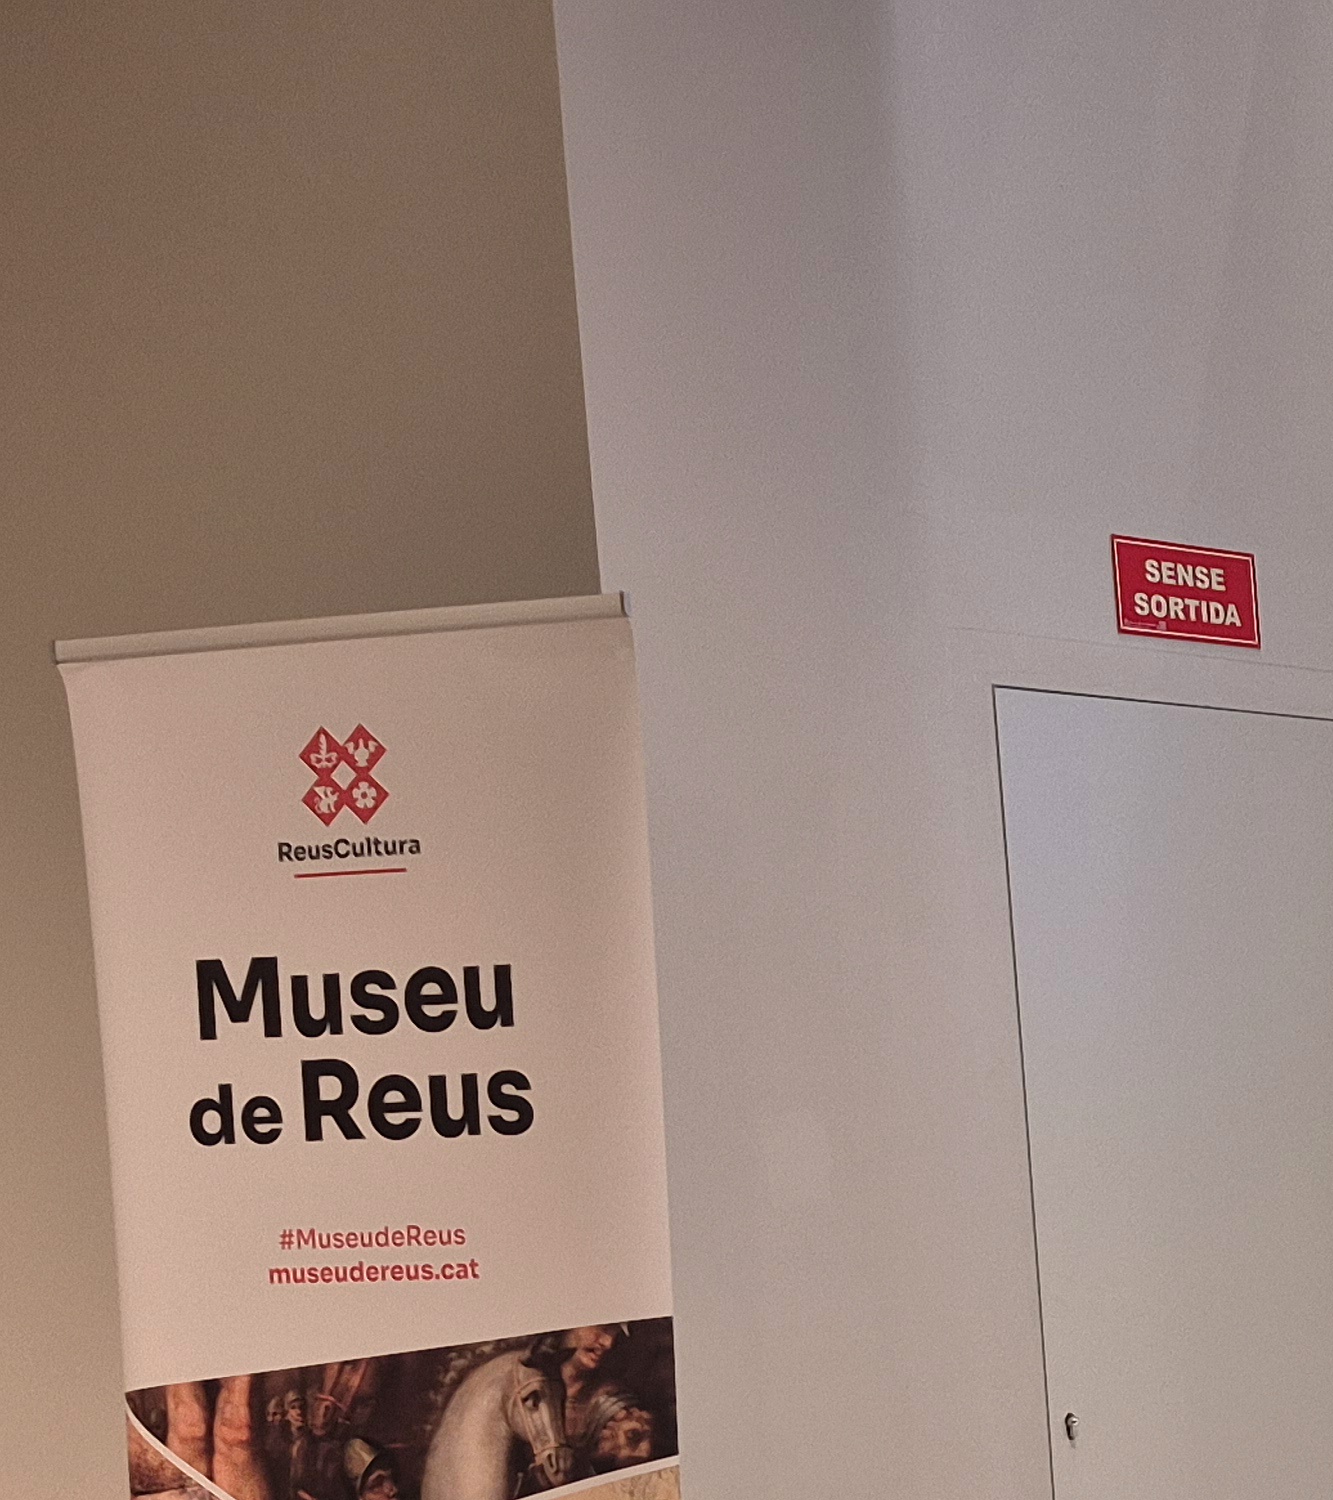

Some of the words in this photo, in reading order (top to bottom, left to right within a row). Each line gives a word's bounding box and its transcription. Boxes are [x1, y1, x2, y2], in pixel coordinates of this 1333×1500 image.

[1145, 559, 1226, 592] SENSE
[1134, 592, 1242, 627] SORTIDA
[277, 834, 422, 863] ReusCultura
[195, 955, 515, 1041] Museu
[189, 1083, 283, 1146] de
[301, 1057, 535, 1142] Reus
[279, 1224, 466, 1251] #MuseudeReus
[268, 1257, 480, 1285] museudereus.cat
